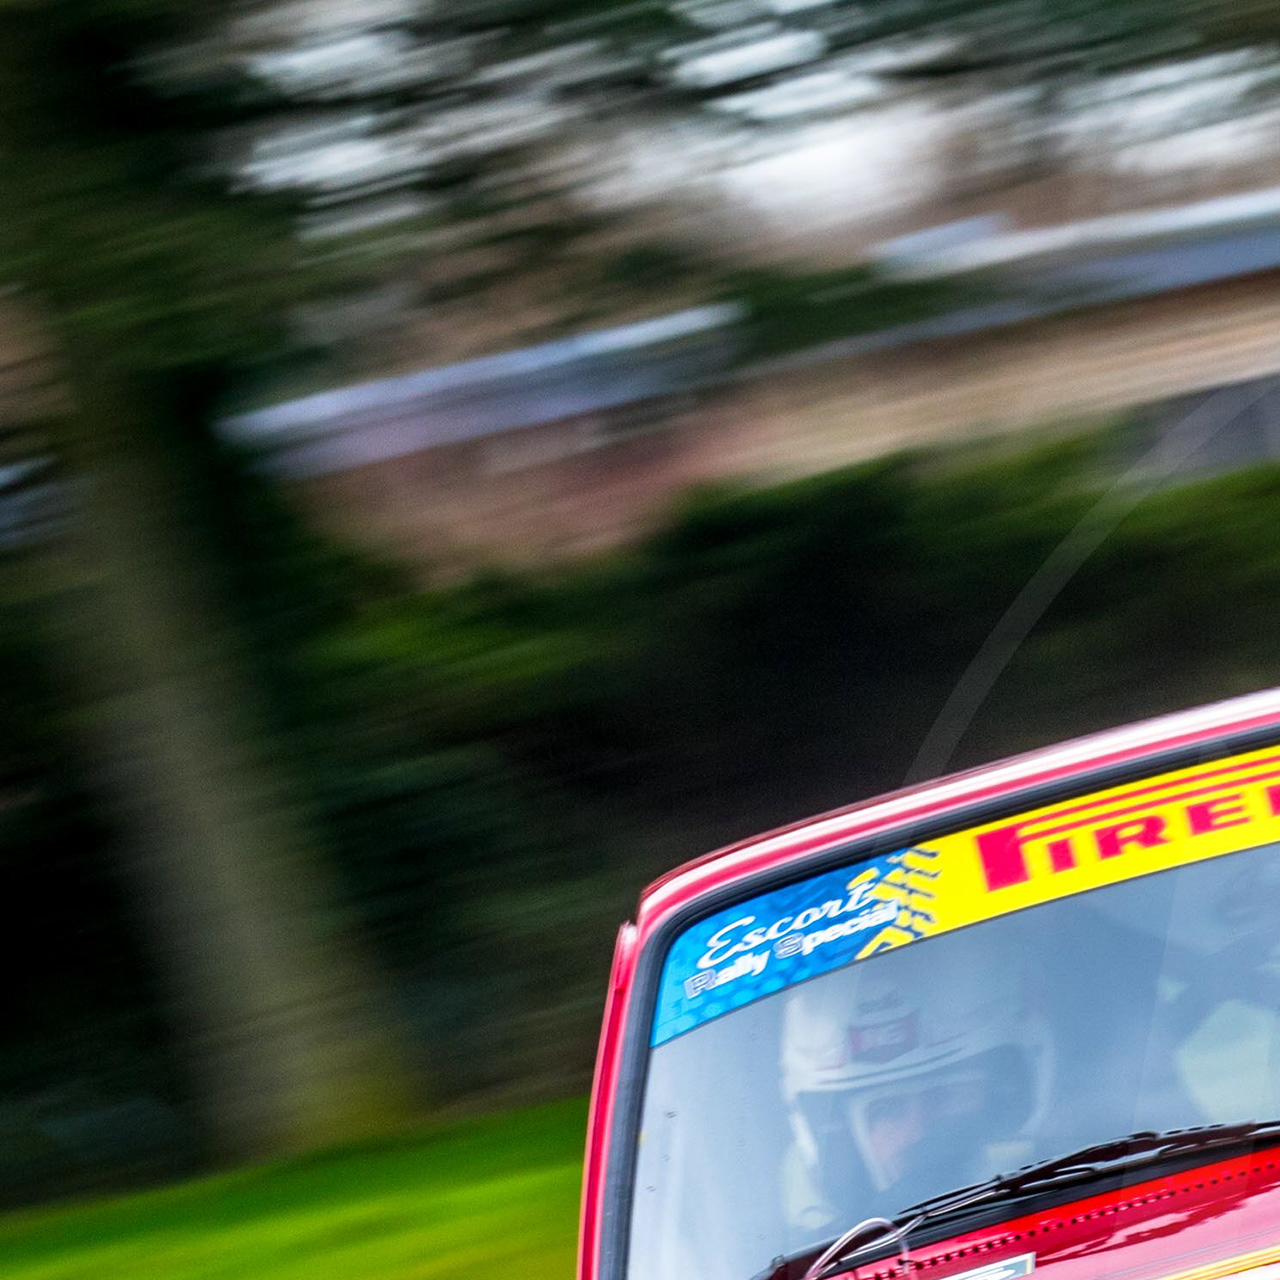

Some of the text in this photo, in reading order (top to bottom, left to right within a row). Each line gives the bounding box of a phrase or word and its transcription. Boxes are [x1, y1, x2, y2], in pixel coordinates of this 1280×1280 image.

[684, 896, 900, 1000] Rally Special
[696, 880, 877, 969] Escort
